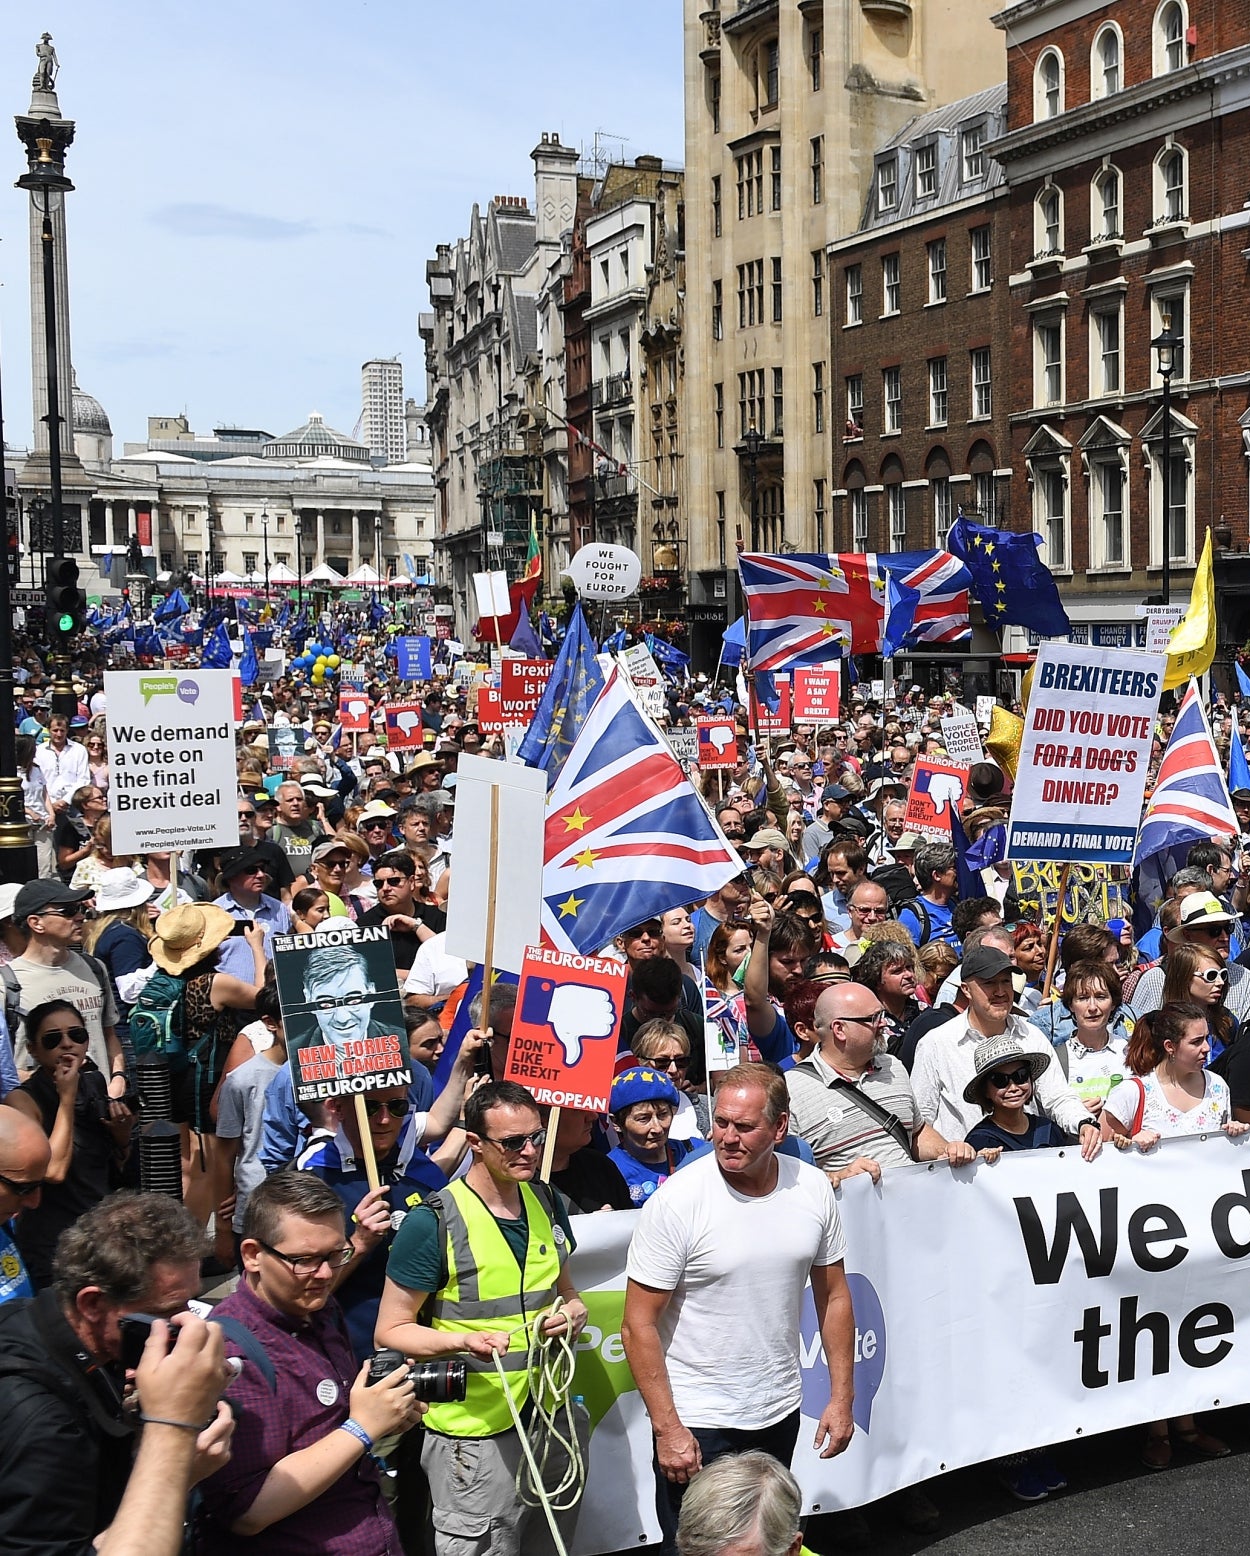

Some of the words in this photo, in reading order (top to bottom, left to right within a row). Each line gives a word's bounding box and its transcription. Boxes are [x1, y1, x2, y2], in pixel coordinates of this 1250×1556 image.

[598, 550, 614, 559] WE
[585, 561, 629, 572] FOUGHT
[594, 572, 615, 581] FOR
[586, 583, 627, 593] EUROPE
[1099, 626, 1127, 635] CHANGE
[1099, 635, 1127, 645] MONEY
[808, 677, 831, 686] WANT
[1039, 662, 1159, 698] BREXITEERS
[143, 682, 175, 691] People's
[180, 687, 198, 696] Vote
[524, 680, 535, 695] is
[803, 707, 830, 715] BREXIT
[943, 722, 976, 732] PEOPLE'S
[1033, 708, 1066, 732] DID
[1069, 710, 1104, 736] YOU
[1106, 713, 1151, 740] VOTE
[112, 725, 146, 743] We
[151, 723, 229, 741] demand
[944, 728, 978, 740] VOICE
[946, 737, 979, 747] PROPER
[948, 743, 981, 754] CHOICE
[115, 752, 126, 766] a
[131, 748, 174, 764] vote
[179, 749, 203, 763] on
[1033, 743, 1068, 768] FOR
[1069, 746, 1083, 769] A
[1085, 747, 1138, 773] DOG'S
[926, 756, 970, 771] EUROPEAN
[115, 772, 148, 788] the
[152, 768, 195, 786] final
[1041, 779, 1120, 806] DINNER?
[117, 792, 176, 811] Brexit
[180, 789, 221, 807] deal
[910, 798, 931, 808] DON'T
[909, 804, 925, 813] LIKE
[908, 811, 934, 821] BREXIT
[135, 824, 217, 836] www.Peoples-Vote.UK
[140, 837, 214, 849] #PeoplesVoteMarch
[1012, 830, 1061, 848] DEMAND
[1062, 832, 1071, 848] A
[1072, 833, 1103, 850] FINAL
[1105, 835, 1134, 851] VOTE
[286, 845, 312, 855] LDN
[274, 937, 293, 945] THE
[294, 926, 389, 950] EUROPEAN
[275, 944, 294, 952] NEW
[527, 946, 542, 955] THE
[525, 953, 543, 962] NEW
[543, 950, 626, 978] EUROPEAN
[298, 1044, 336, 1065] NEW
[342, 1035, 401, 1058] TORIES
[514, 1037, 556, 1055] DON'T
[512, 1050, 544, 1066] LIKE
[300, 1063, 336, 1083] NEW
[342, 1052, 403, 1076] DANGER
[510, 1063, 561, 1081] BREXIT
[297, 1085, 317, 1095] THE
[317, 1069, 412, 1099] EUROPEAN
[298, 1092, 318, 1102] NEW
[1013, 1187, 1189, 1285] We
[1074, 1296, 1235, 1390] the
